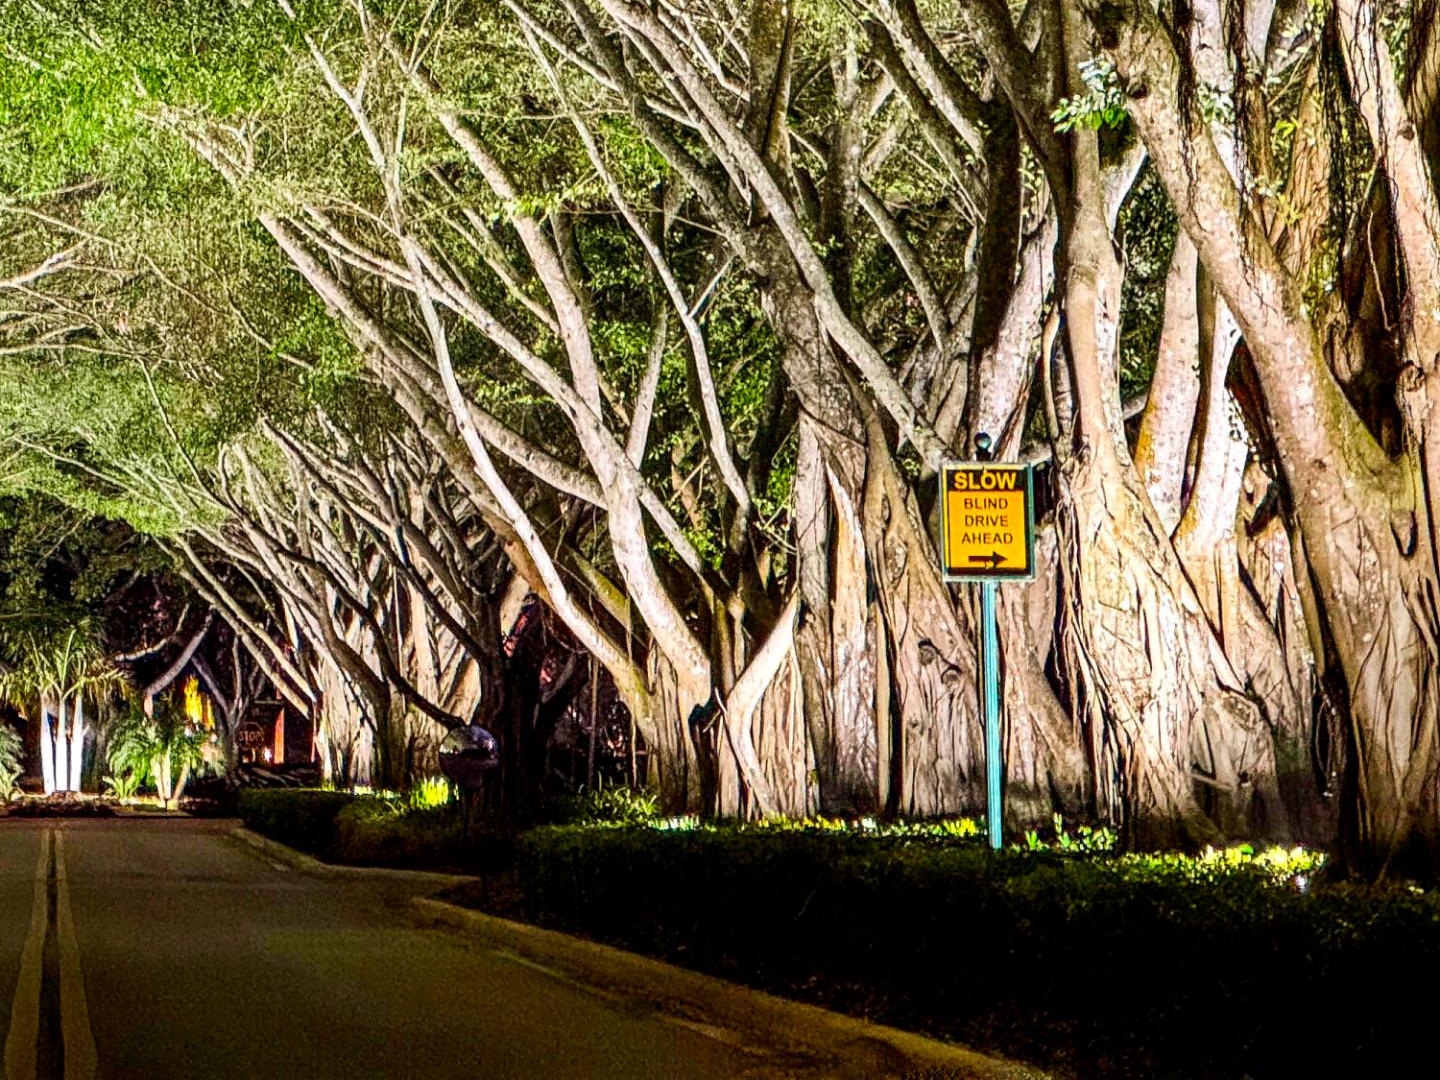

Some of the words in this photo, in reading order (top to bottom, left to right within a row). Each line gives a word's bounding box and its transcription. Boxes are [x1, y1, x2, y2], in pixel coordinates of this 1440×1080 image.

[954, 471, 1016, 490] SLOW
[964, 498, 1008, 510] BLIND
[964, 515, 1009, 527] DRIVE
[961, 532, 1013, 544] AHEAD
[238, 730, 261, 743] STOP
